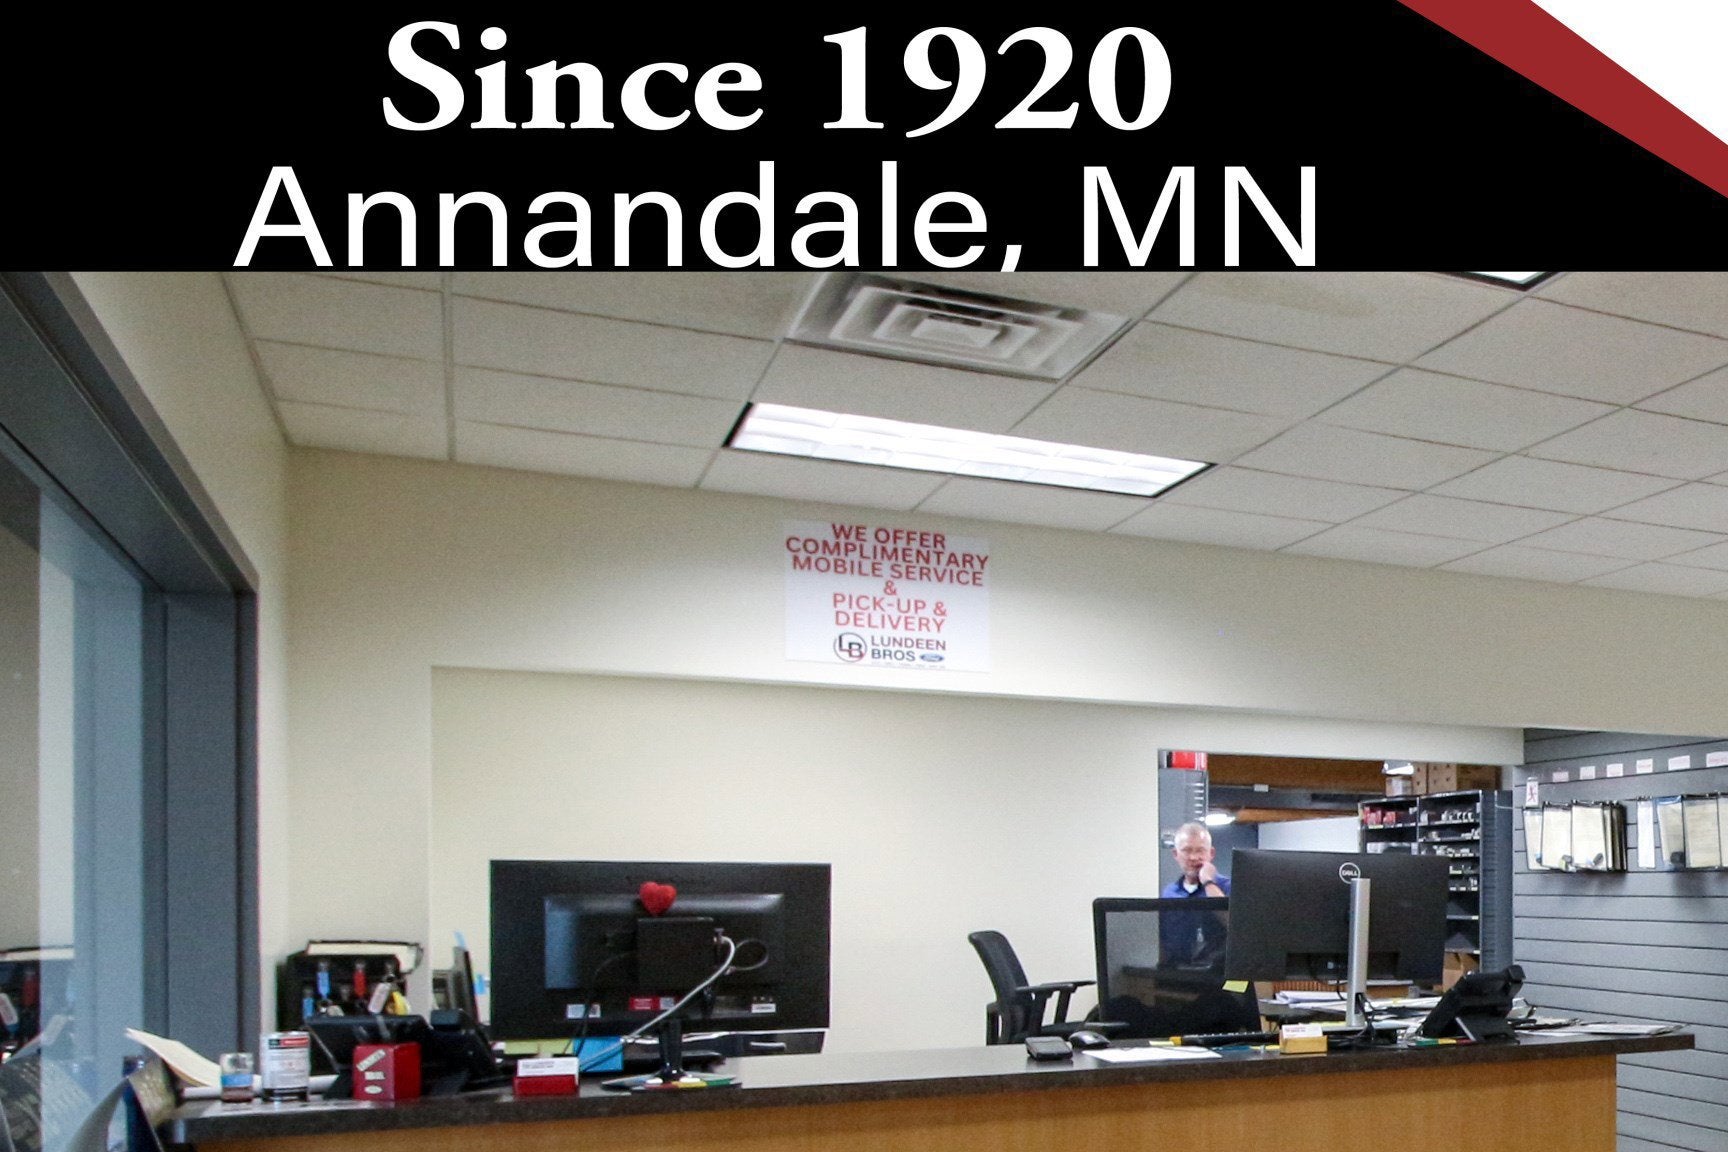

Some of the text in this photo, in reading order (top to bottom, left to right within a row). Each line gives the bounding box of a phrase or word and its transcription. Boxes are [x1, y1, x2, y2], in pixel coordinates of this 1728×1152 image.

[831, 523, 946, 549] WE OFFER
[786, 536, 989, 570] COMPLIMENTARY
[792, 555, 984, 587] MOBILE SERVICE
[883, 580, 897, 596] &
[832, 592, 947, 617] PICK-UP &
[835, 610, 945, 633] DELIVERY
[871, 635, 946, 651] LUNDEEN
[871, 648, 916, 661] BROS
